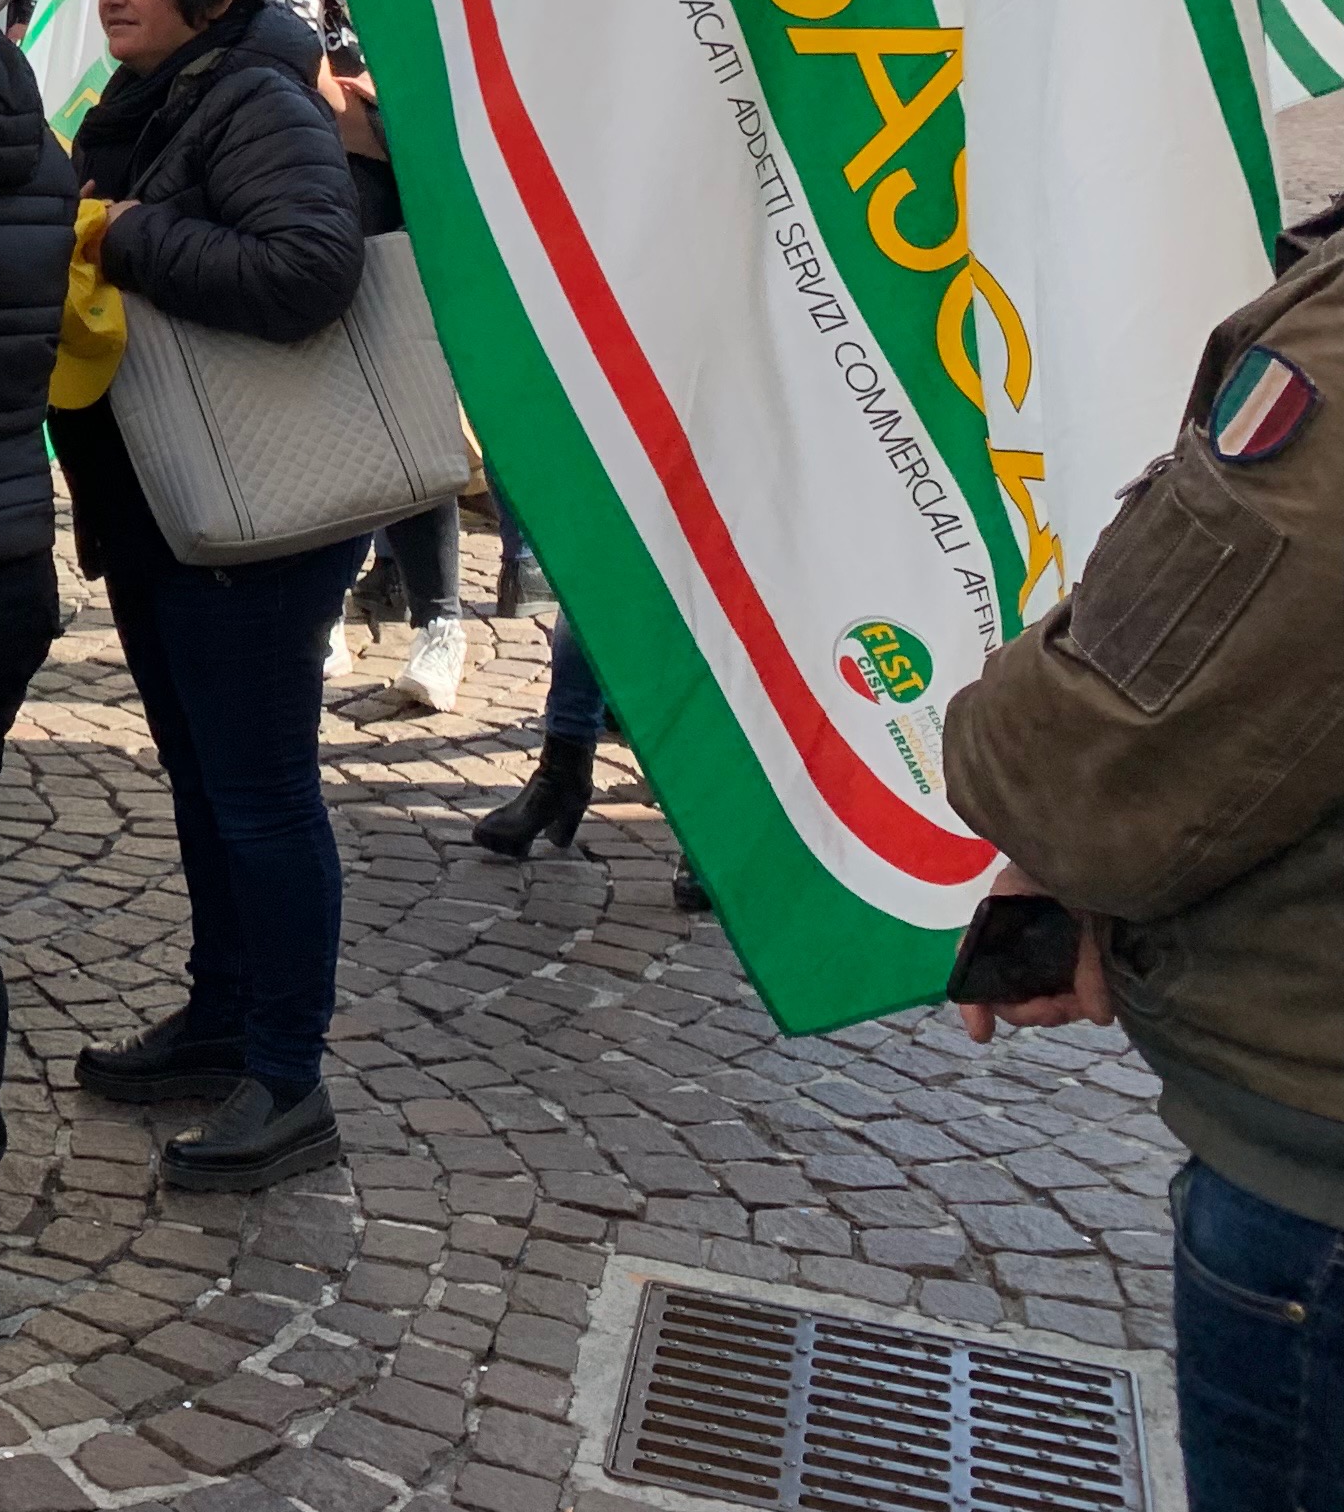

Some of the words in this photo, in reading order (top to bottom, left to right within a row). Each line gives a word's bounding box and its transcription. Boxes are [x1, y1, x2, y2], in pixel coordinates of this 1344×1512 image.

[727, 95, 796, 219] ADDETTI
[775, 222, 849, 334] SERVIZI
[834, 341, 970, 555] COMMERCIALI
[953, 566, 1001, 659] AFFIN
[856, 655, 889, 702] CISL
[884, 718, 932, 796] TERZIARIO
